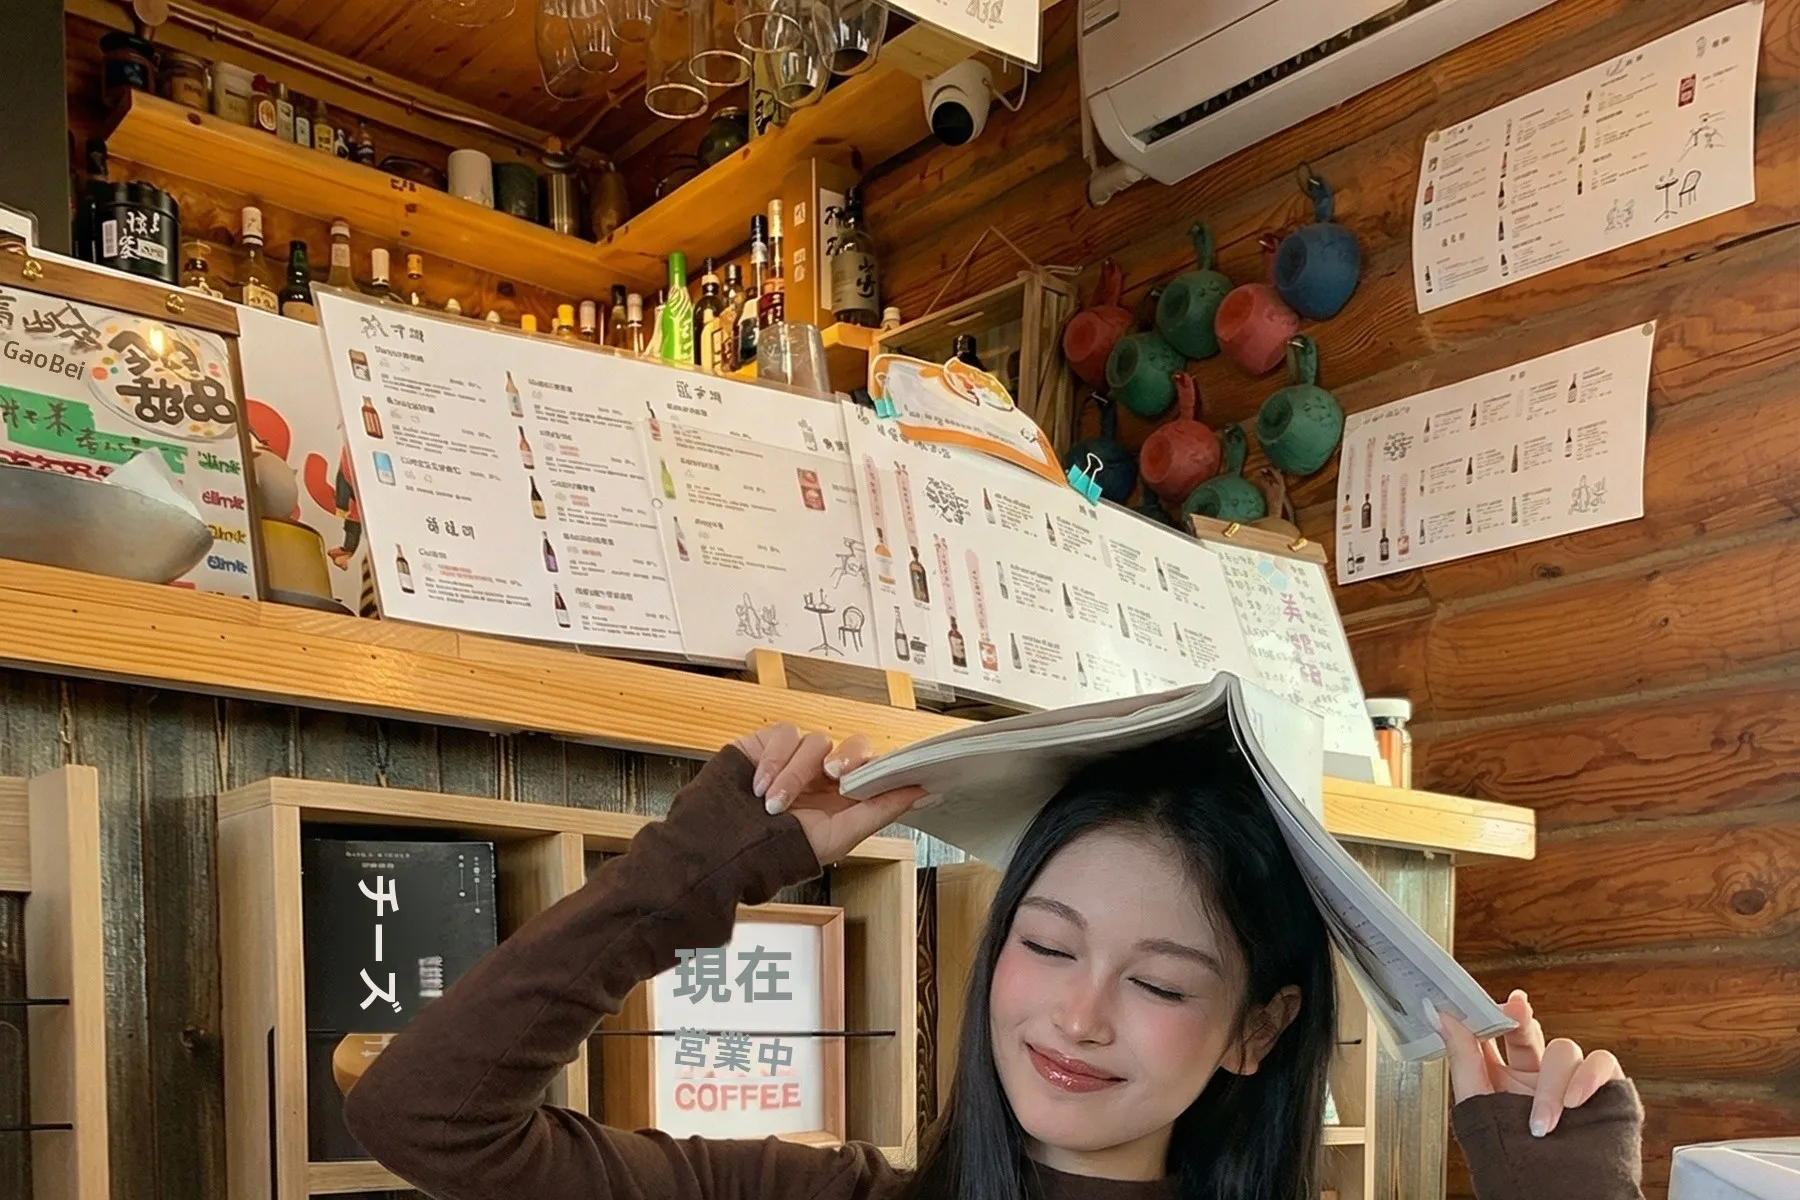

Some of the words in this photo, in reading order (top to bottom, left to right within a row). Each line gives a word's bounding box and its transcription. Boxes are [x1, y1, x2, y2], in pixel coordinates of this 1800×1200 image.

[3, 340, 86, 381] GaoBei
[358, 875, 403, 1014] チーズ
[673, 944, 793, 1005] 現在
[674, 1026, 794, 1077] 営業中
[674, 1081, 802, 1112] COFFEE
